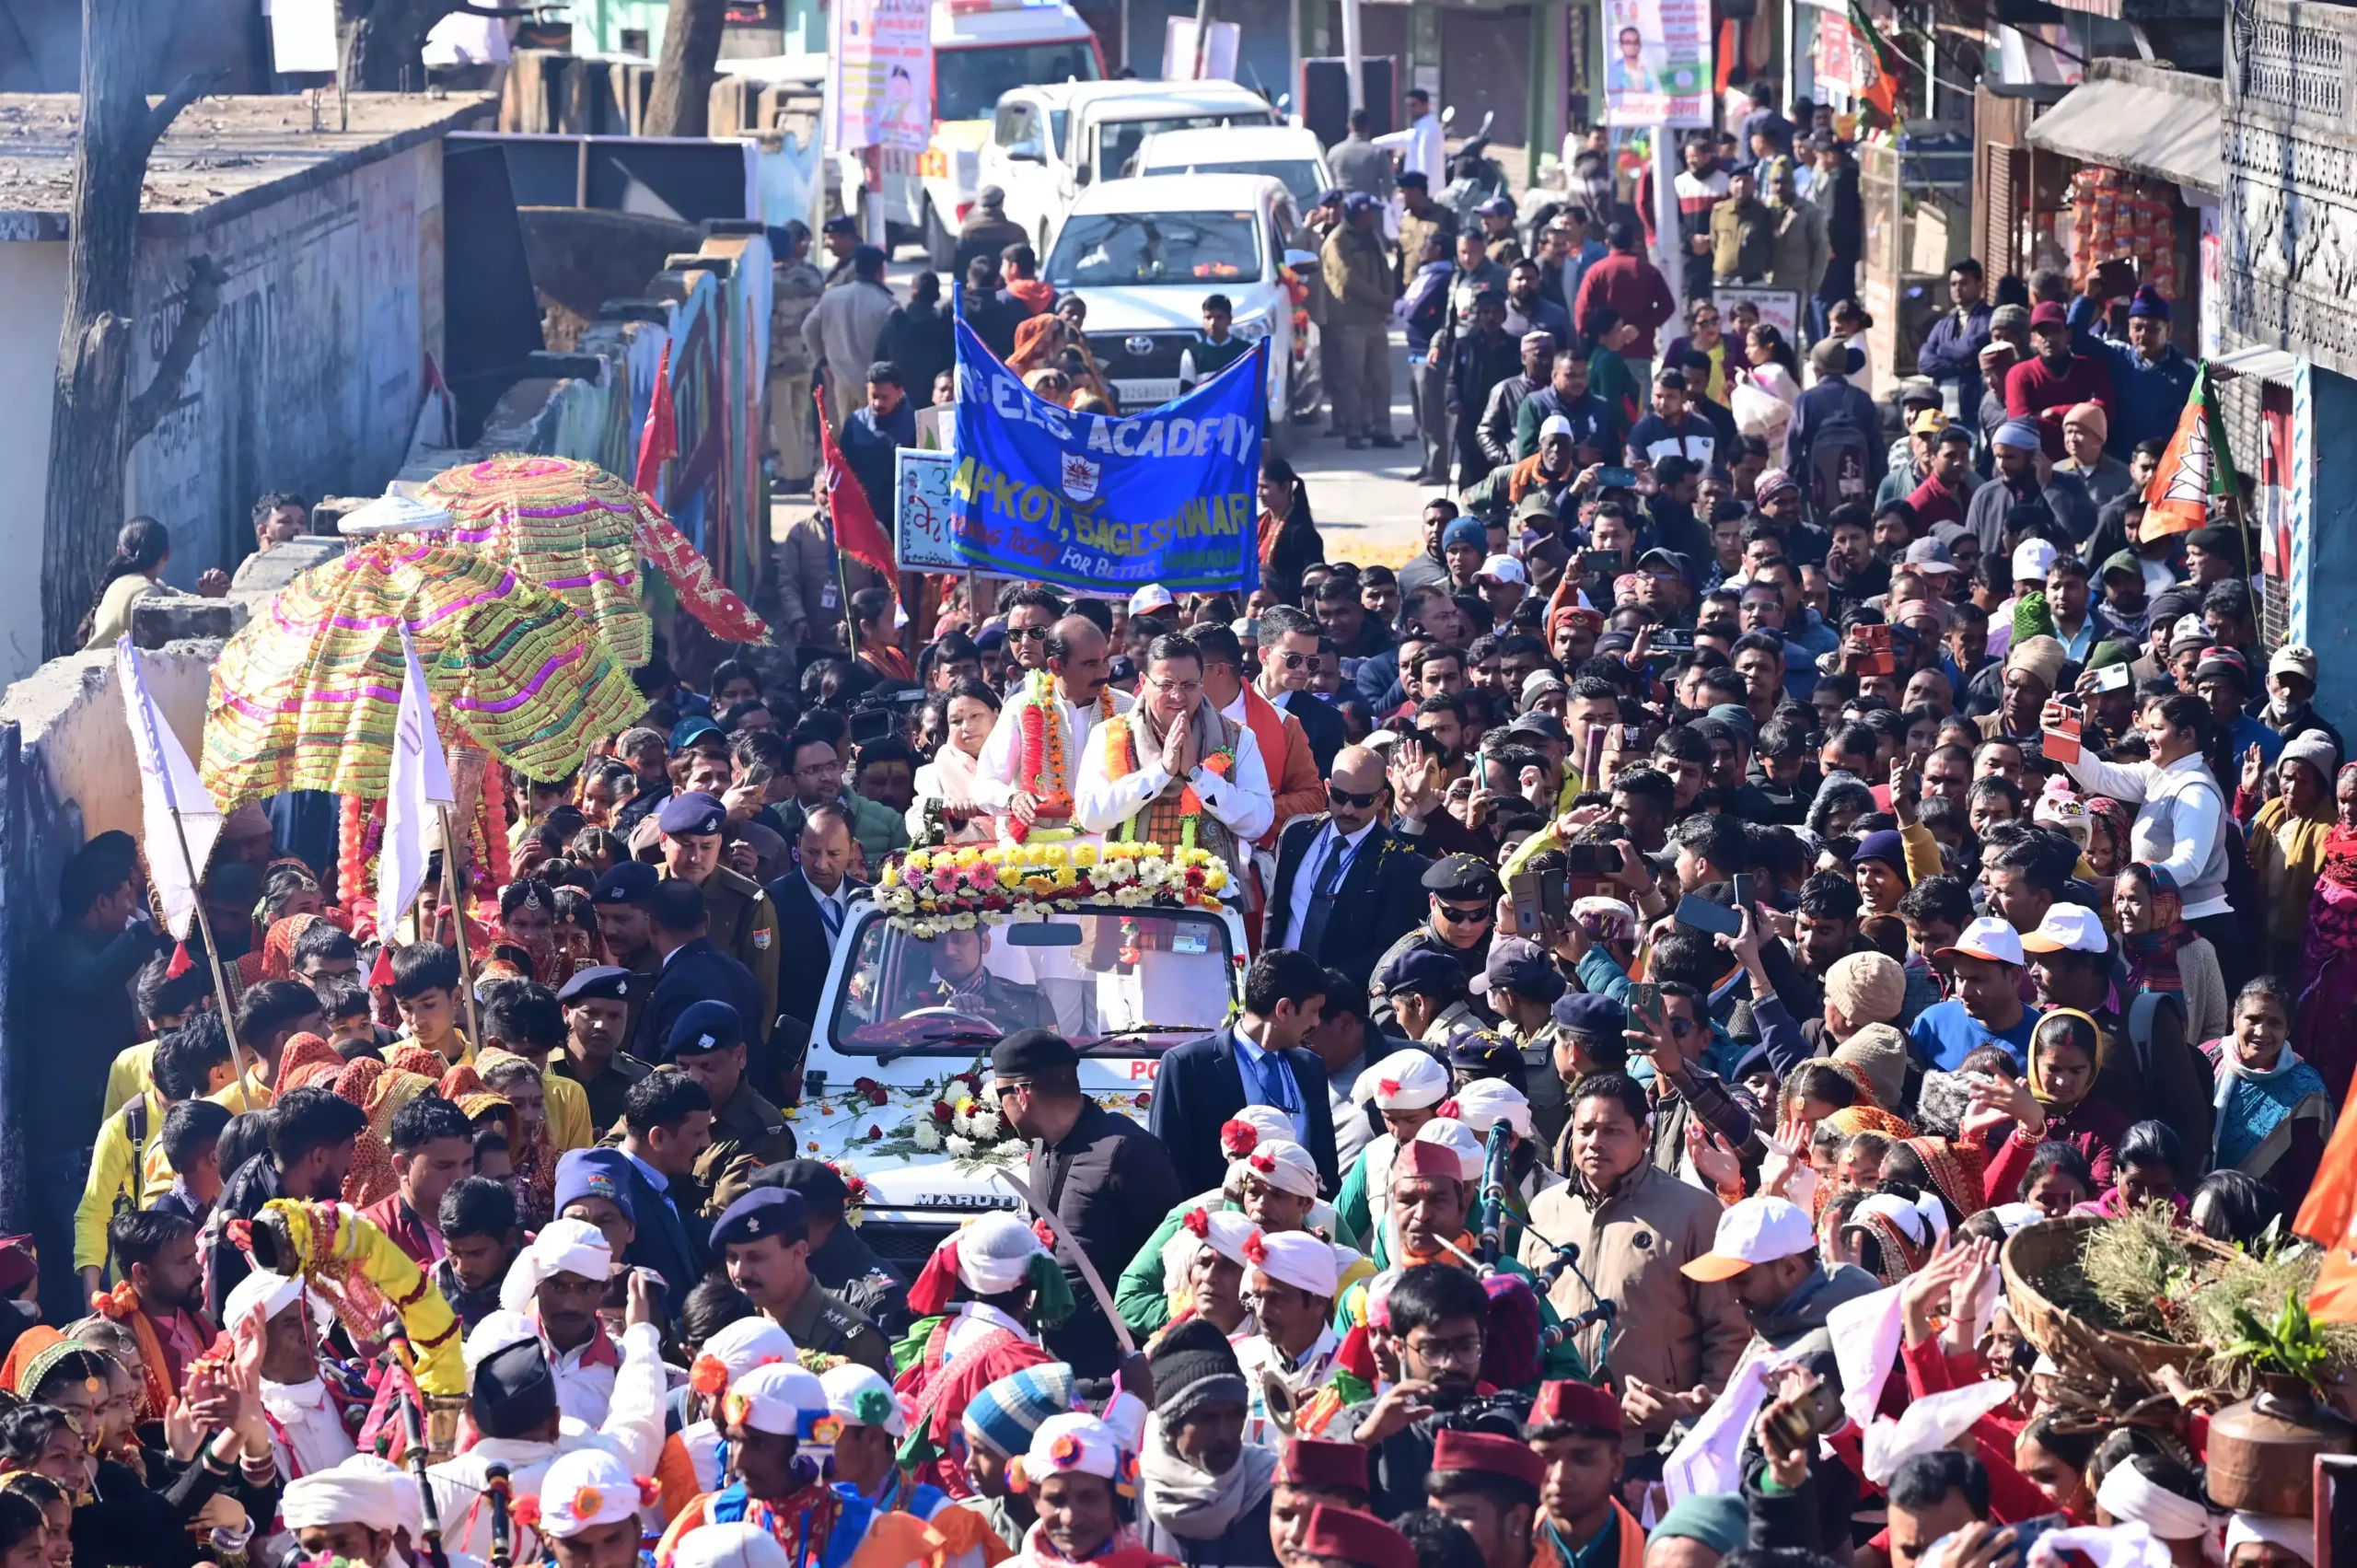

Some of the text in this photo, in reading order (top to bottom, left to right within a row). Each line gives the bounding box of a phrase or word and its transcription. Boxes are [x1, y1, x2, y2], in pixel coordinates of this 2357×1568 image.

[953, 363, 1255, 465] NGELS' ACADEMY
[950, 455, 1069, 542] APKOT,
[1072, 494, 1250, 556] BAGESHWAR
[1061, 545, 1090, 576] FOR
[1094, 557, 1156, 579] BETTER
[914, 1193, 1019, 1207] MARUTI
